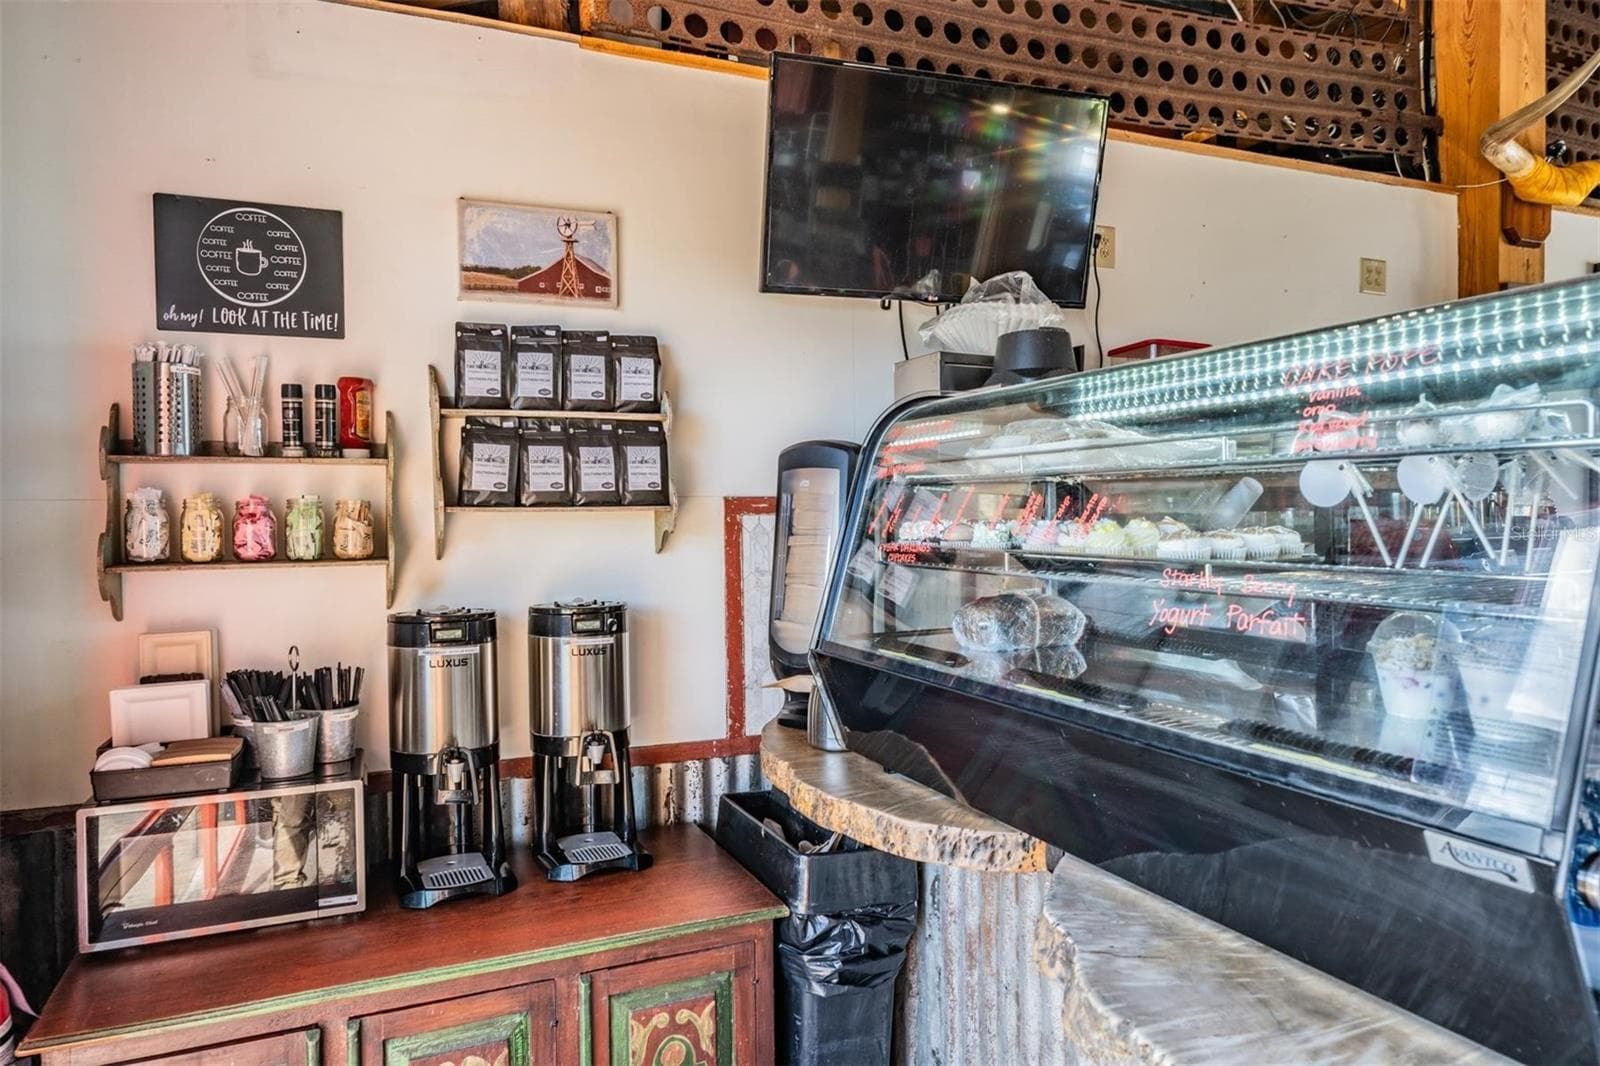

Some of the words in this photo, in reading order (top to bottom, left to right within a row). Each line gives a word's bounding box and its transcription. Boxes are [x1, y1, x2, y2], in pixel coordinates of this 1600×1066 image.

[235, 213, 267, 223] COFFEE
[210, 225, 234, 233] COFFEE
[267, 230, 291, 238] COFFEE
[202, 238, 227, 246] COFFEE
[275, 244, 298, 252] COFFEE
[200, 250, 232, 259] COFFEE
[271, 256, 302, 265] COFFEE
[206, 264, 231, 272] COFFEE
[274, 270, 298, 278] COFFEE
[213, 279, 238, 287] COFFEE
[237, 292, 269, 301] COFFEE
[163, 305, 179, 321] oh
[180, 309, 204, 327] my!
[212, 308, 247, 326] LOOK
[252, 310, 268, 328] AT
[273, 311, 297, 329] THE
[1284, 358, 1352, 386] CAKE
[1149, 599, 1211, 634] Yogurt
[1226, 604, 1305, 635] Parfait
[571, 647, 608, 657] LUXUS
[429, 658, 469, 668] LUXUS
